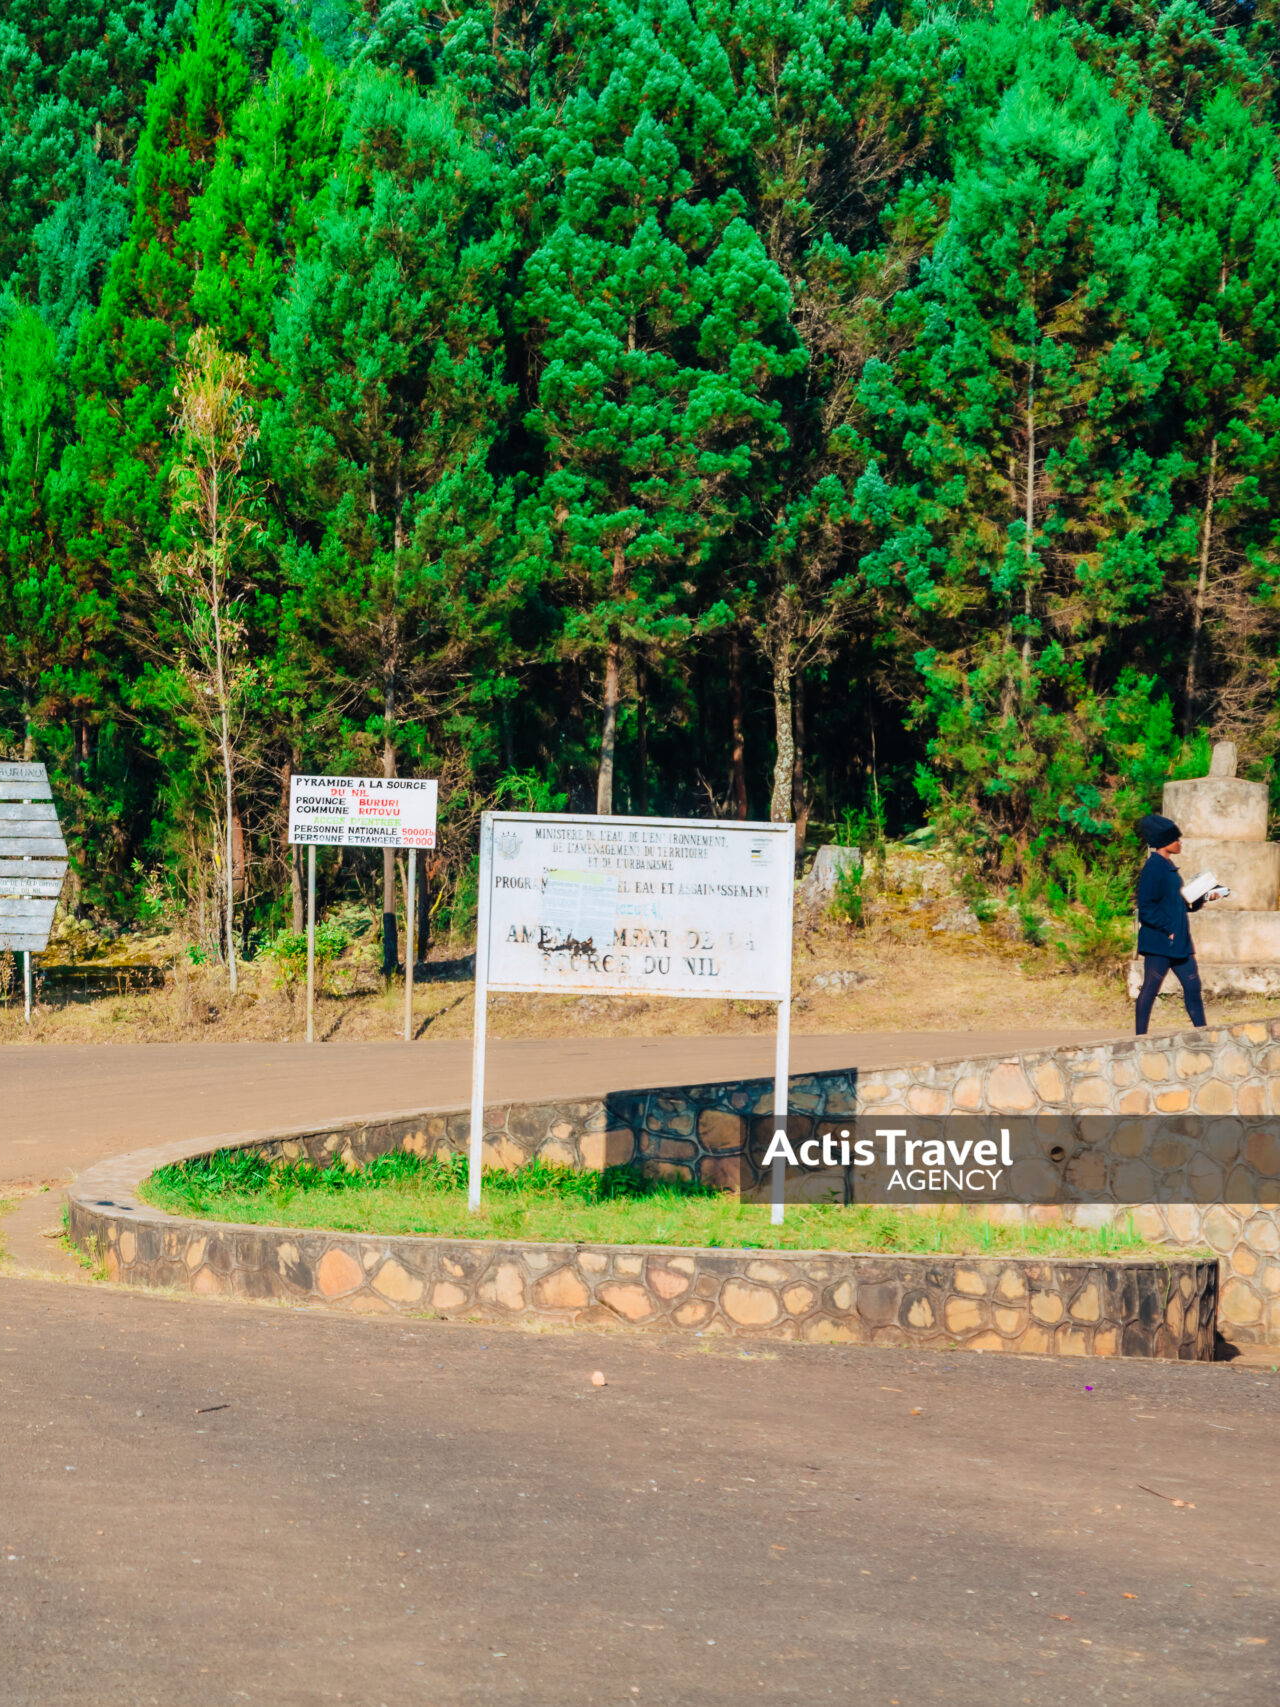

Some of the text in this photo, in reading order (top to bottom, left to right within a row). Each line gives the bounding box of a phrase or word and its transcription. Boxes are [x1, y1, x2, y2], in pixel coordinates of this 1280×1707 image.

[296, 777, 427, 790] PYRAMIDE A LA SOURCE
[331, 788, 369, 797] DU NIL
[296, 796, 399, 807] PROVINCE BURURI
[296, 805, 401, 817] COMMUNE RUTOVU
[294, 824, 344, 834] PERSONNE
[348, 826, 398, 836] NATIONALE
[294, 833, 344, 843] PERSONNE
[348, 835, 402, 845] ETRANGERE
[629, 831, 639, 843] DE
[553, 842, 562, 853] DE
[658, 846, 709, 859] TERRITOIRE
[588, 856, 598, 868] ET
[636, 881, 655, 894] EAU
[661, 882, 674, 895] ET
[644, 955, 671, 975] DU
[683, 956, 721, 977] NIL
